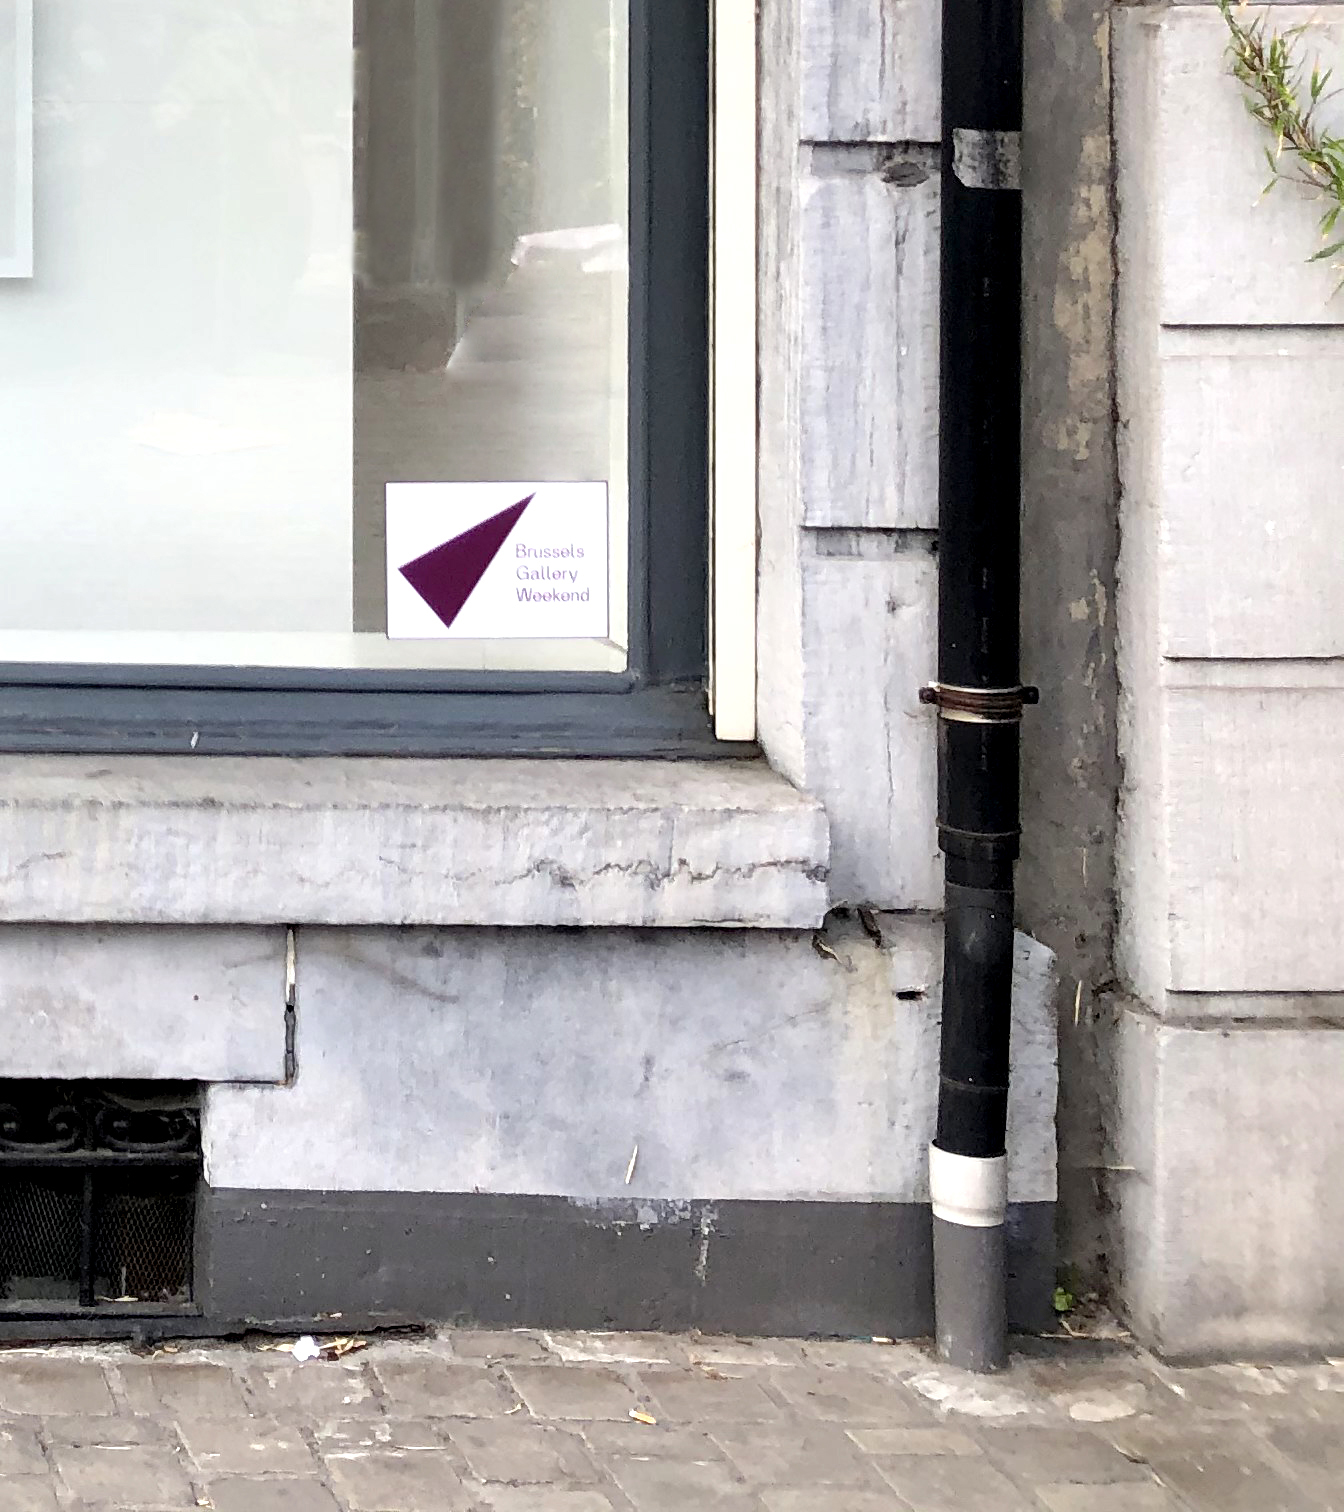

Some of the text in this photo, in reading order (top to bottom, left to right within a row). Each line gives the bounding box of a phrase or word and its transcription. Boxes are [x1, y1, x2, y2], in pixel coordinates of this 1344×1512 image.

[515, 543, 585, 559] Brussels
[515, 564, 579, 583] Gallery
[515, 586, 591, 603] Weekend
